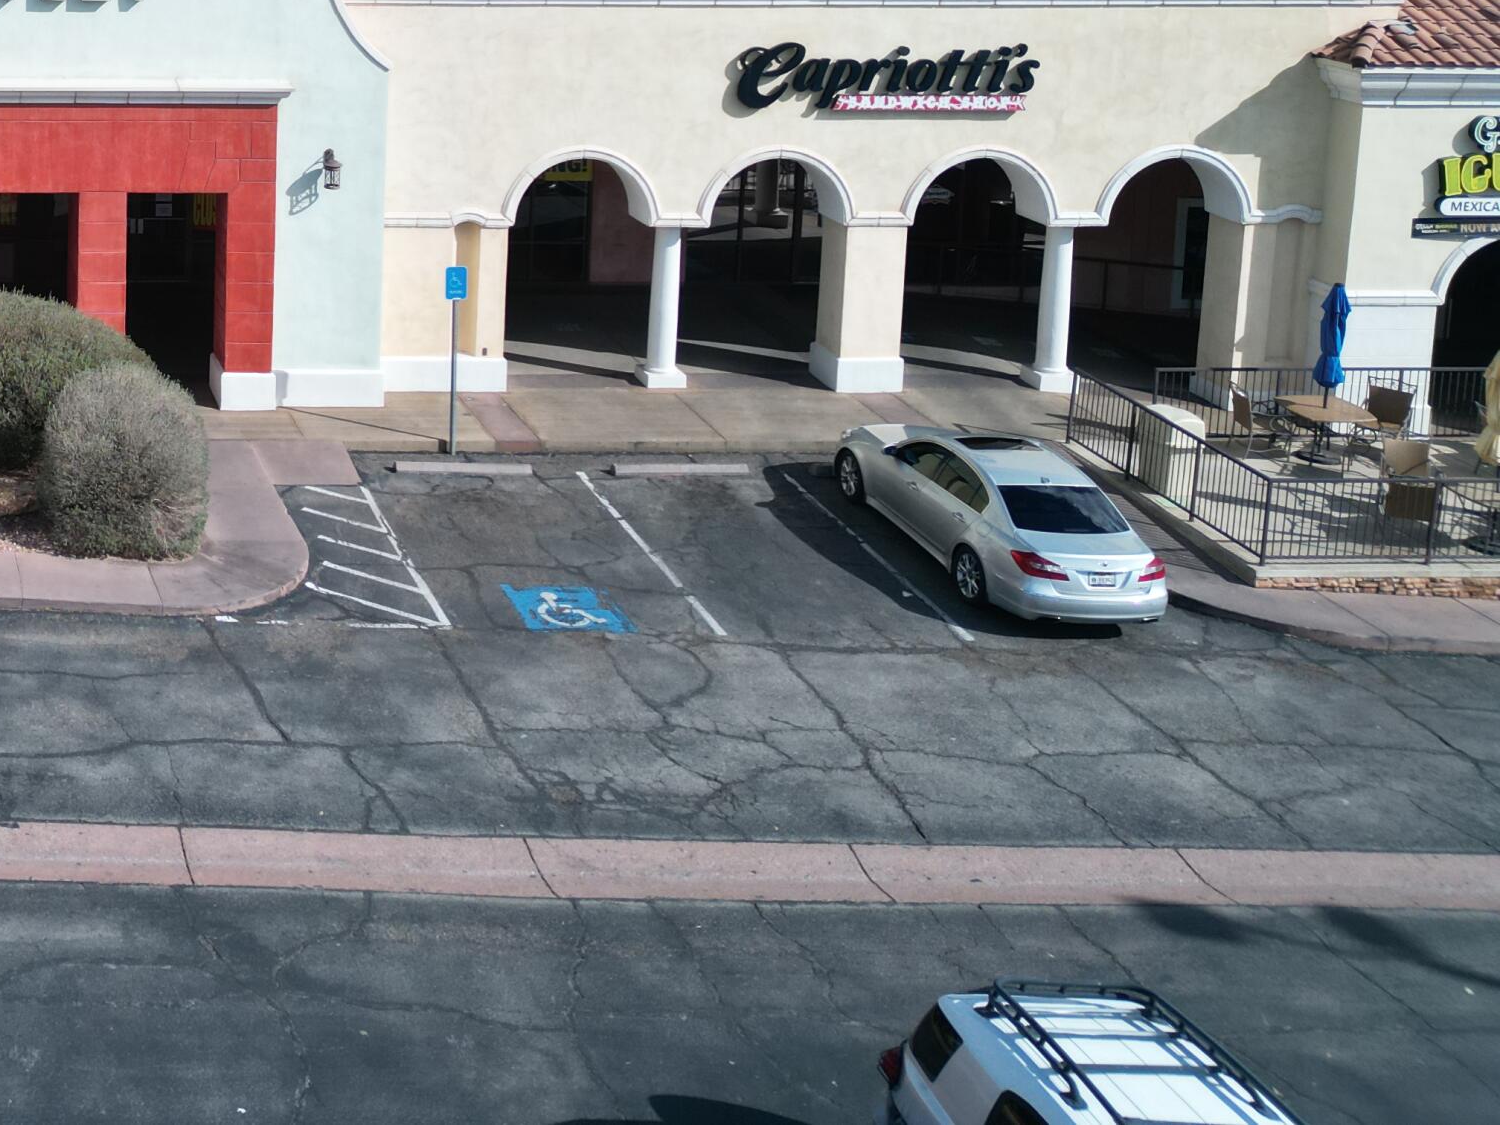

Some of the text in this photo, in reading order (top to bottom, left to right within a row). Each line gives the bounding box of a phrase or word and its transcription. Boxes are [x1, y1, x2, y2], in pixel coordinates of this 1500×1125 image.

[736, 41, 1041, 110] Capriotti's
[846, 95, 950, 109] SANDWICH
[1474, 116, 1500, 153] G
